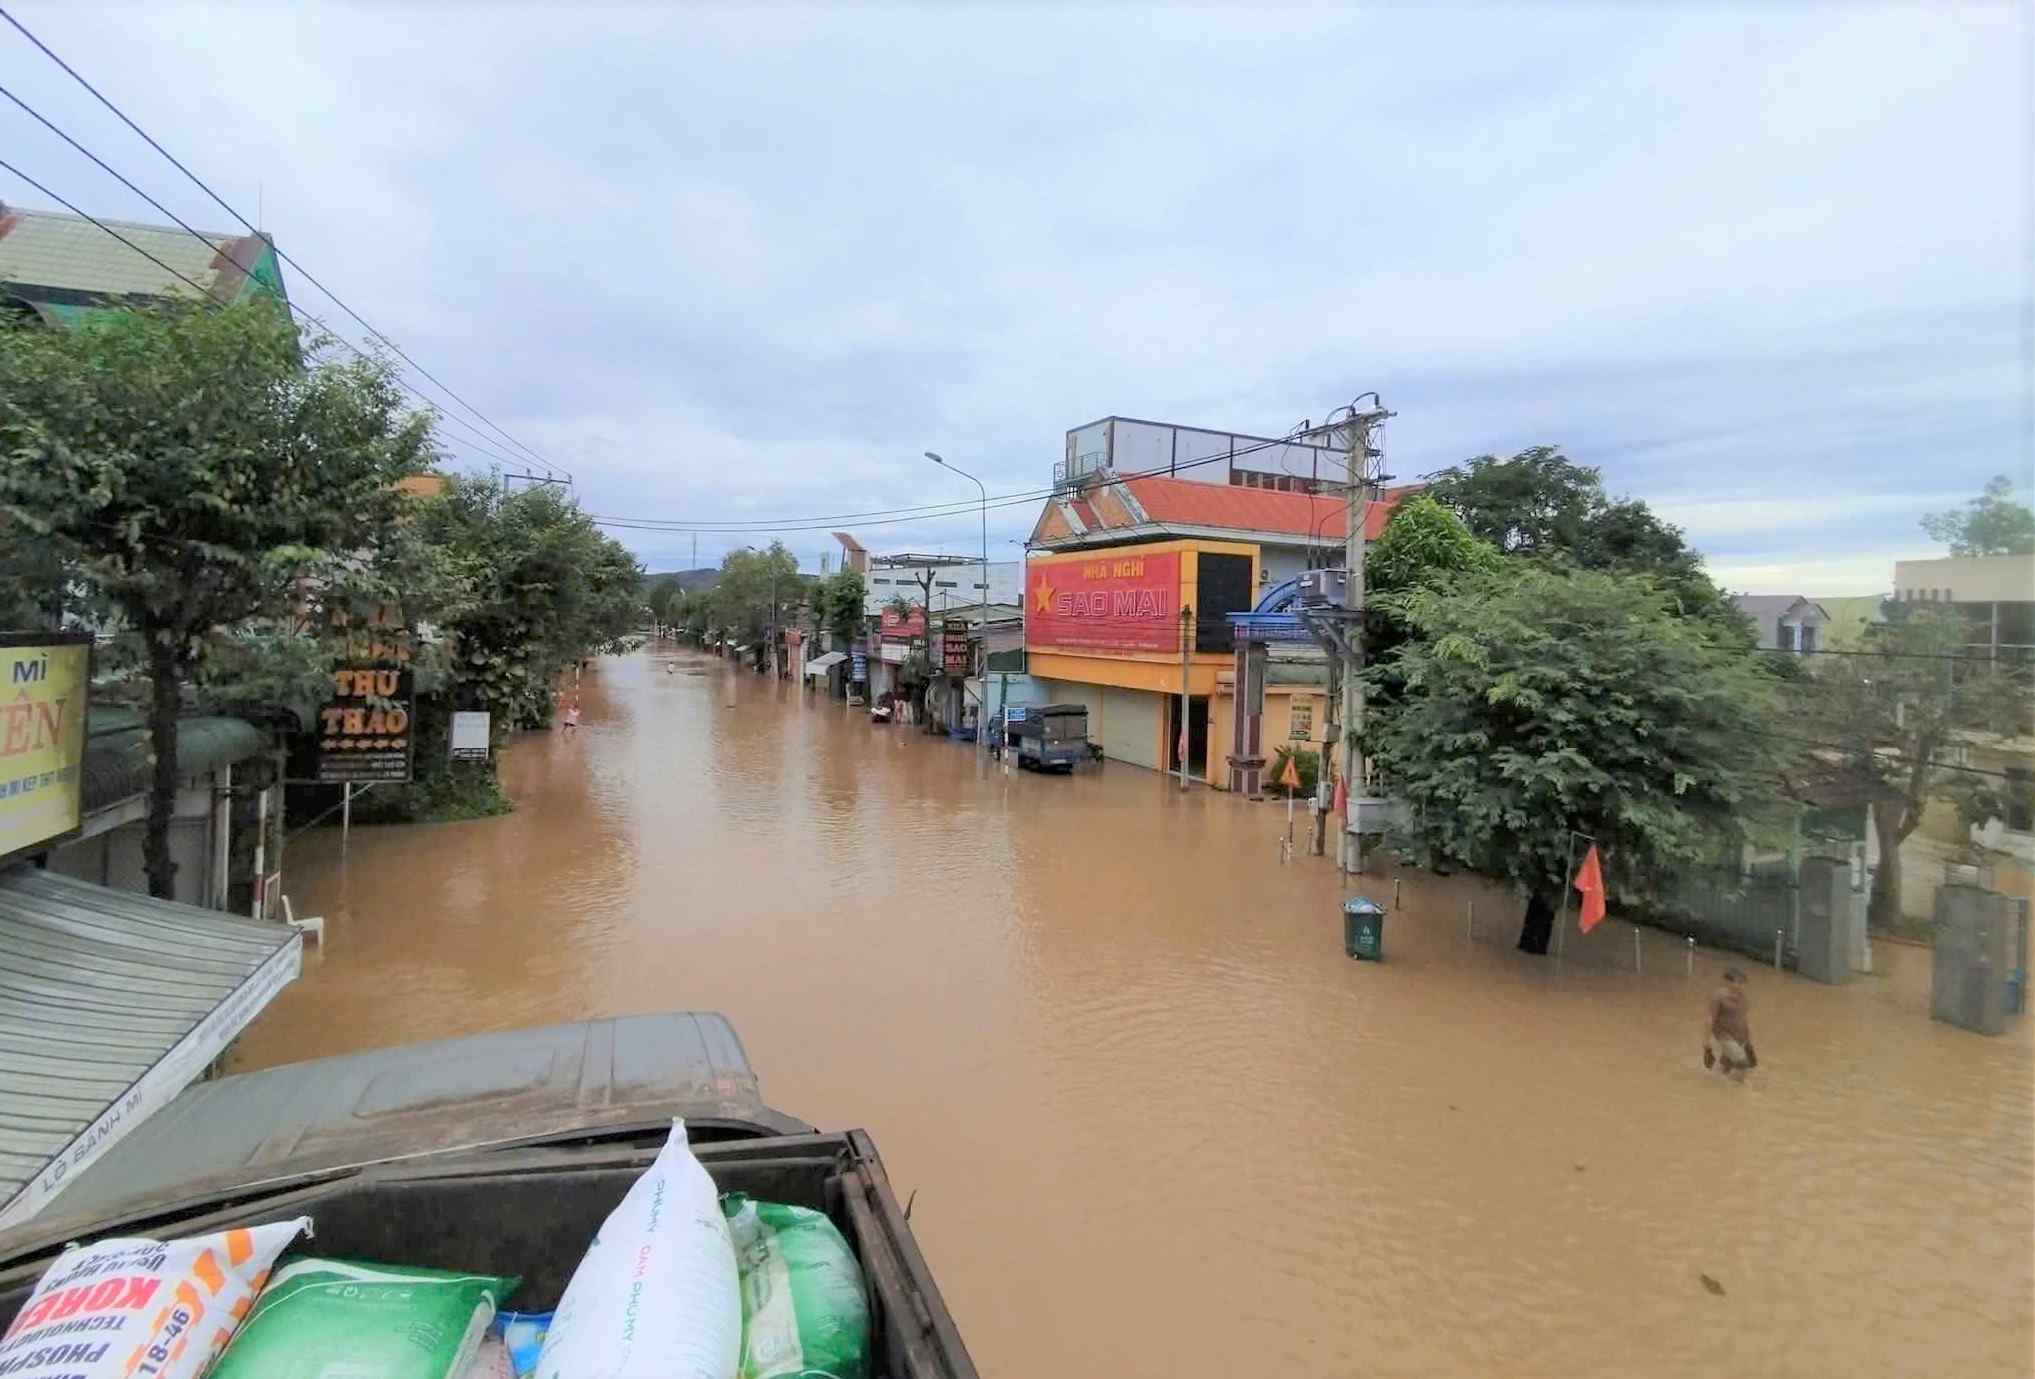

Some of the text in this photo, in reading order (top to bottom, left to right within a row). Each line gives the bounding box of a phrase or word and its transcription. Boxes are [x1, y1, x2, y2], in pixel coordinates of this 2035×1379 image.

[1056, 589, 1168, 618] SAO MAI
[13, 652, 48, 683] MÌ
[138, 1309, 190, 1376] 18-46
